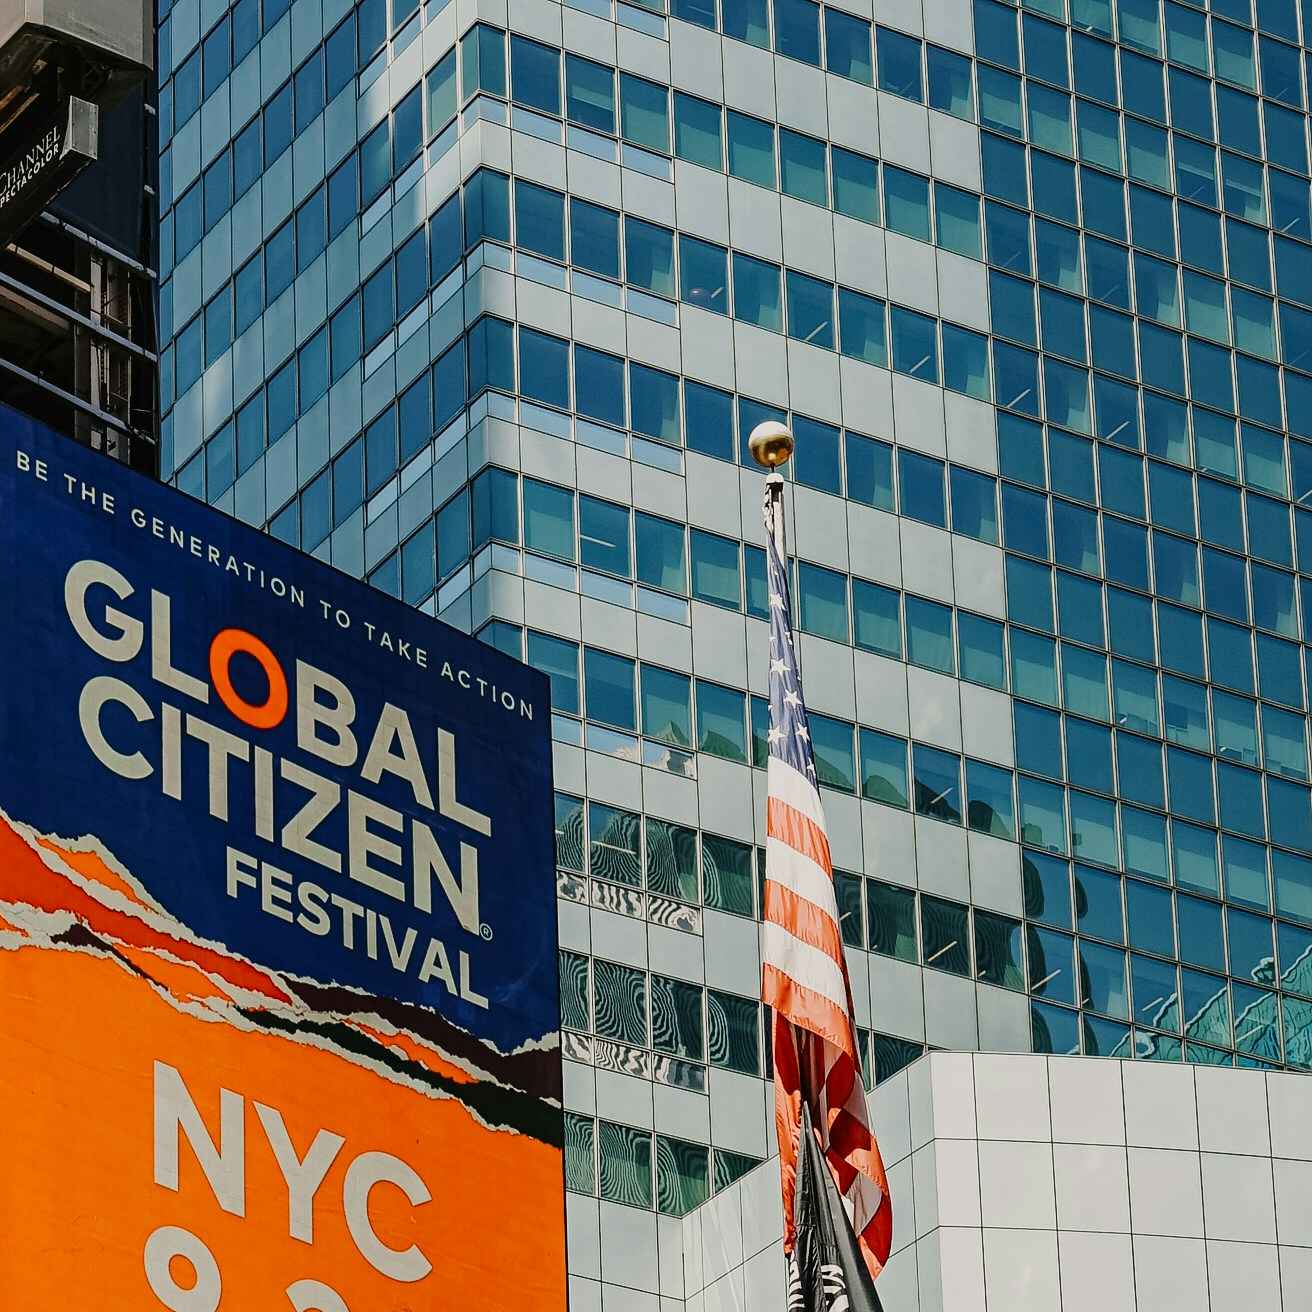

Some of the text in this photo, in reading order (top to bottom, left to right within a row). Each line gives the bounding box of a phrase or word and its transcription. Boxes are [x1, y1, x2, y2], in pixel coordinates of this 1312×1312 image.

[16, 450, 534, 721] BE THE GENERATION TO TAKE ACTION
[64, 559, 492, 837] GLOBAL
[226, 846, 489, 1009] FESTIVAL
[153, 1059, 433, 1283] NYC
